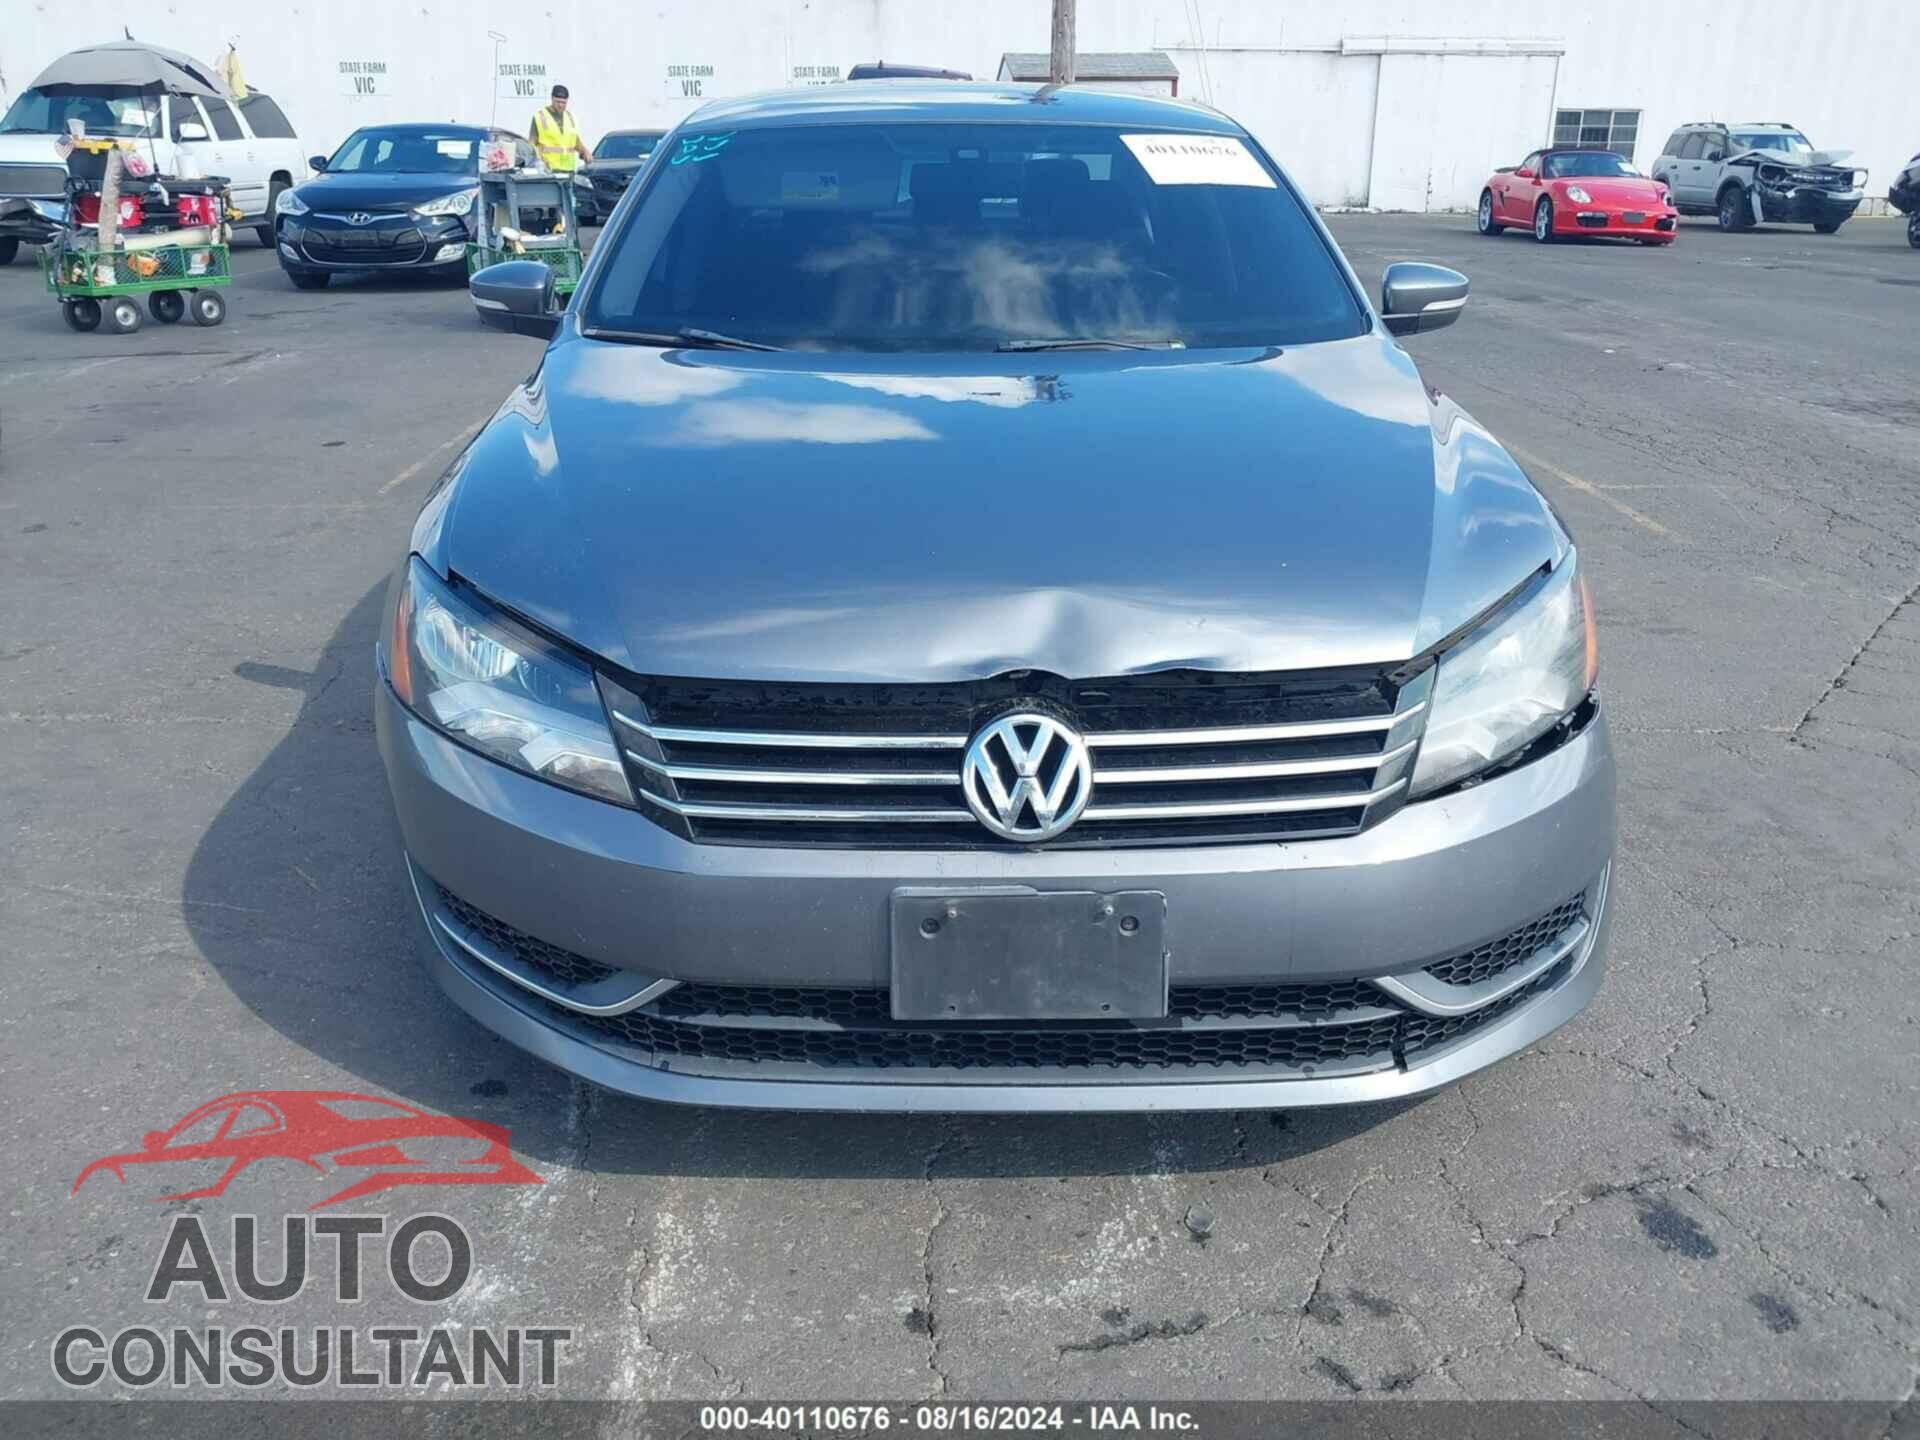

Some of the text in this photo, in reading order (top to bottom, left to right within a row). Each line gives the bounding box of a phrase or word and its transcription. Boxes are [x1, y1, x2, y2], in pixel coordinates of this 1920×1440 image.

[339, 62, 386, 74] STATE FARM
[499, 64, 546, 76] STATE FARM
[667, 65, 714, 78] STATE FARM
[794, 66, 839, 78] STATE FARM
[354, 77, 375, 94] VIC
[514, 79, 535, 96] VIC
[682, 80, 702, 97] VIC
